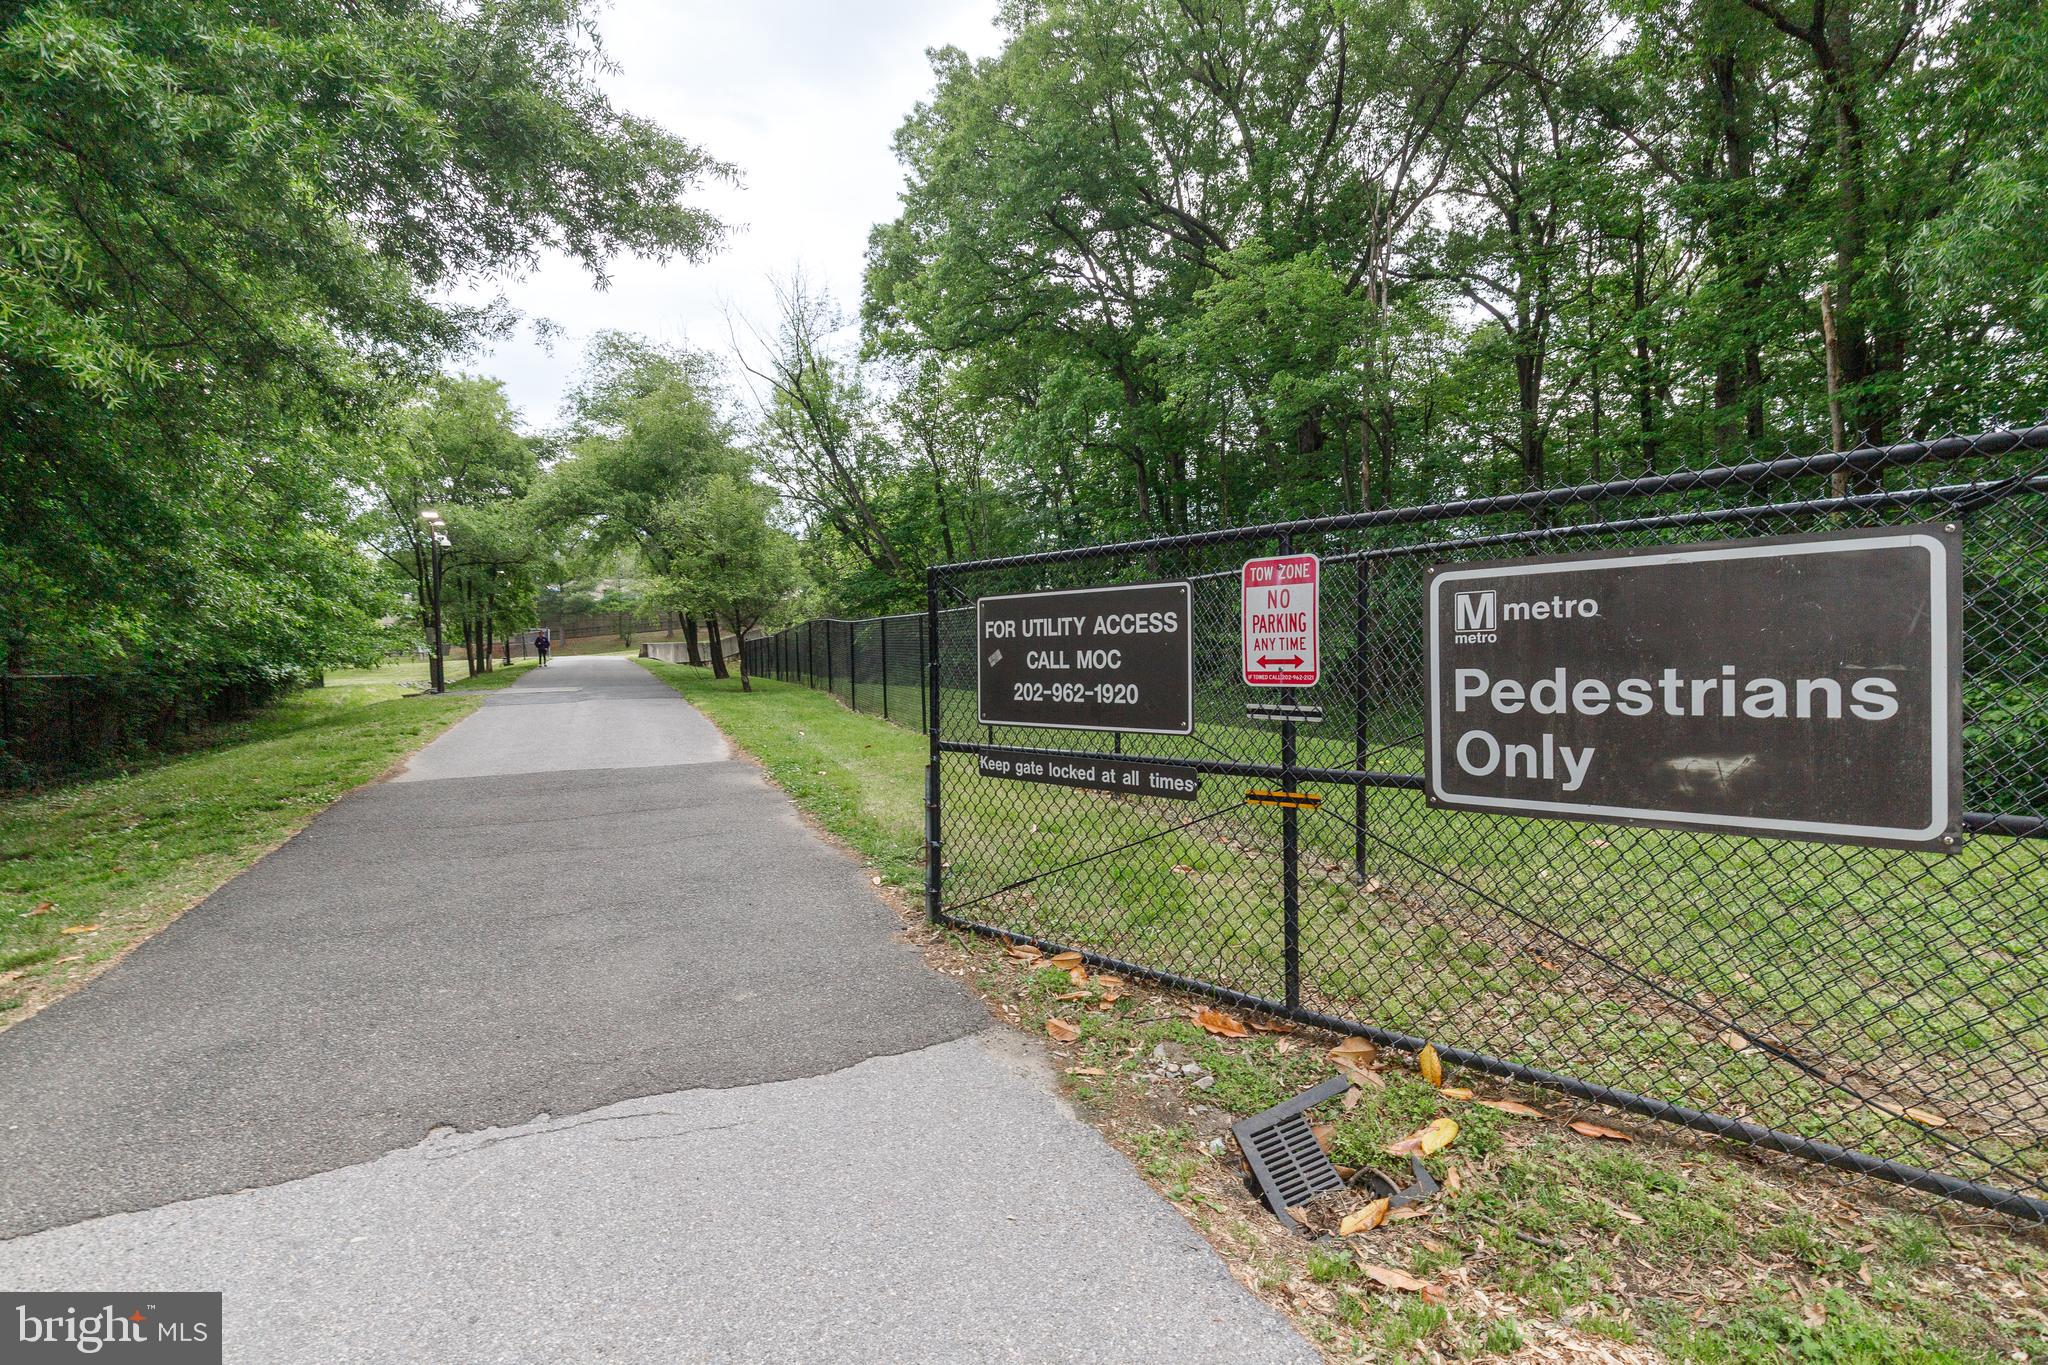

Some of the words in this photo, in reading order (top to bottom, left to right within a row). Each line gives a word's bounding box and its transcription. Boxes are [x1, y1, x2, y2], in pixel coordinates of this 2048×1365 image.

[1250, 566, 1274, 582] TOW
[1279, 563, 1311, 580] ZONE
[1267, 588, 1290, 609] NO
[1503, 596, 1599, 621] metro
[1252, 612, 1307, 634] PARKING
[1457, 593, 1494, 630] M
[985, 620, 1016, 638] FOR
[1022, 616, 1086, 637] UTILITY
[1093, 612, 1178, 636] ACCESS
[1253, 637, 1276, 651] ANY
[1279, 636, 1307, 651] TIME
[1455, 632, 1497, 644] metro
[1026, 650, 1070, 669] CALL
[1076, 649, 1122, 670] MOC
[1013, 682, 1139, 705] 202-962-1920
[1454, 664, 1900, 721] Pedestrians
[1456, 729, 1596, 791] Only
[980, 756, 1010, 774] Keep
[1015, 761, 1044, 776] gate
[1049, 763, 1095, 782] locked
[1101, 768, 1116, 784] at
[1122, 770, 1140, 786] all
[1149, 773, 1194, 793] times
